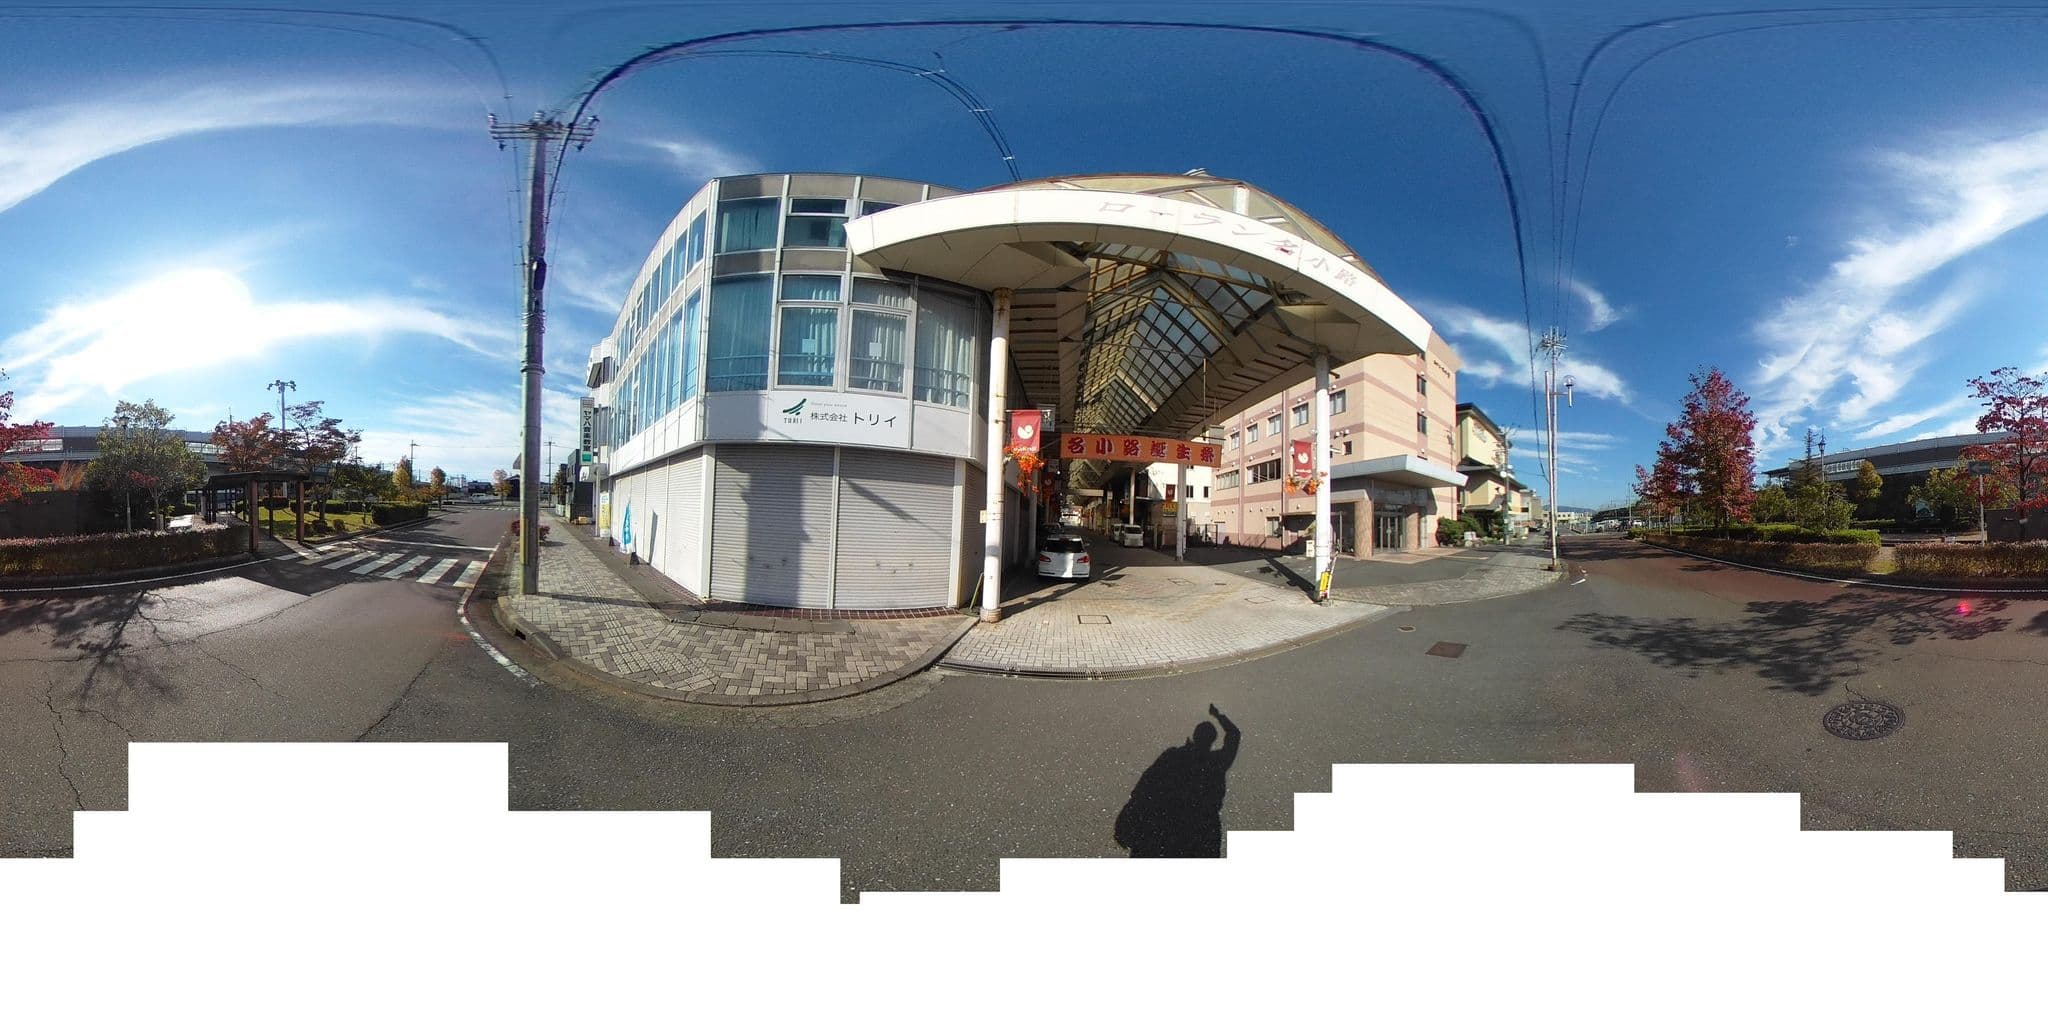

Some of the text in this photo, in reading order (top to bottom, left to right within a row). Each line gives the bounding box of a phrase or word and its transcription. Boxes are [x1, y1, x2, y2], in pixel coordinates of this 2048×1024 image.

[810, 411, 897, 428] 株式会社 トリイ
[1067, 436, 1216, 463] 名小路誕生祭
